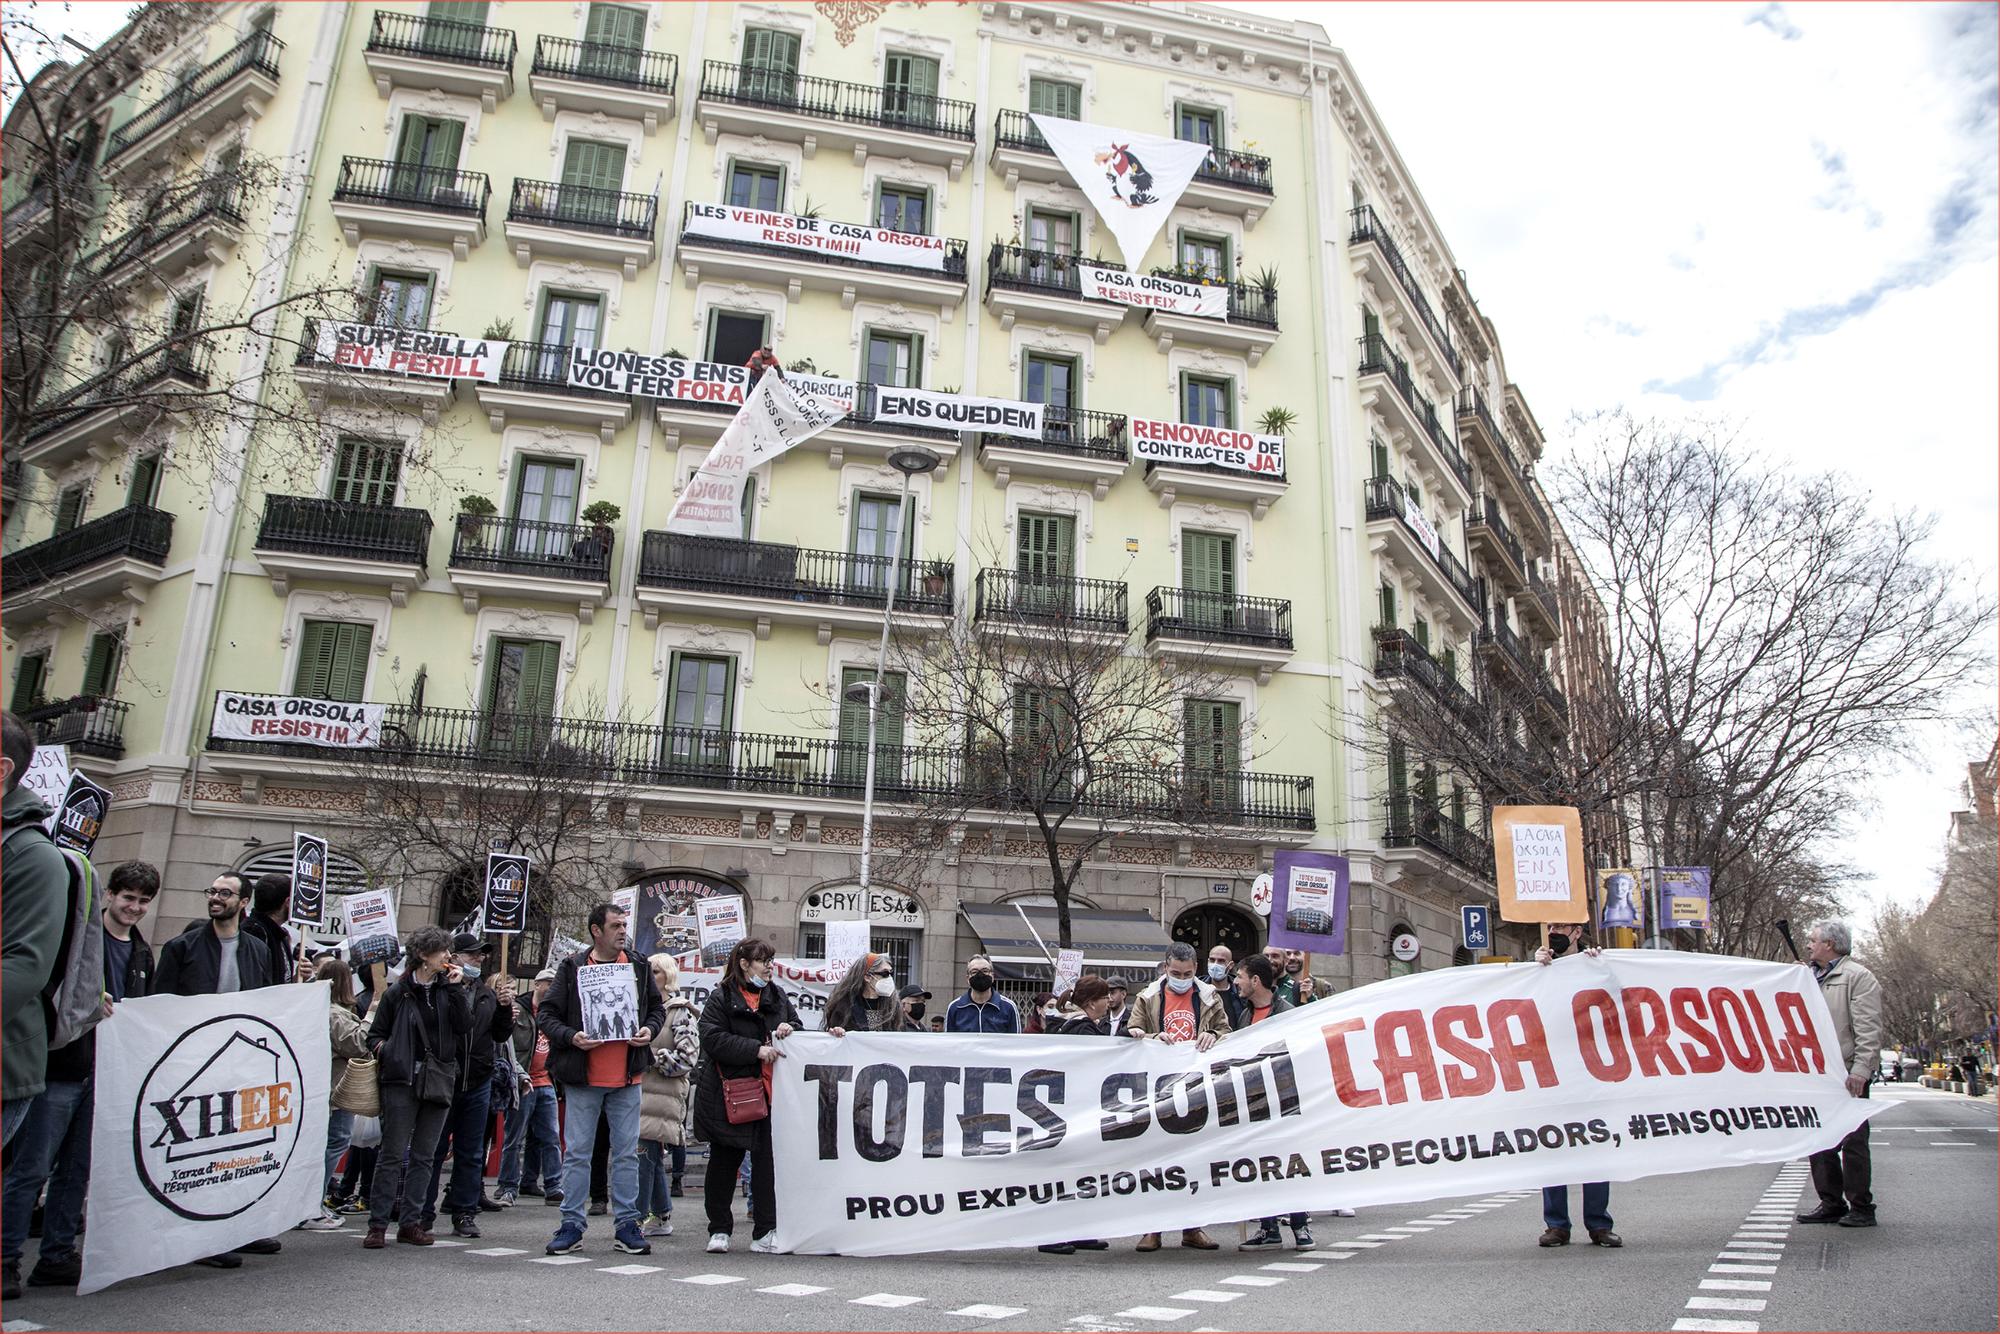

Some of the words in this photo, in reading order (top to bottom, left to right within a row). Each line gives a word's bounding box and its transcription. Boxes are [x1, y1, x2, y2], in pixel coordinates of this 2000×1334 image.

[695, 204, 726, 219] LES
[797, 219, 818, 232] DE
[829, 224, 872, 241] CASA
[877, 231, 943, 250] ORSOLA
[1095, 271, 1134, 288] CASA
[1141, 277, 1202, 299] ORSOLA
[1097, 286, 1177, 309] RESISTEIX
[340, 325, 488, 358] SUPERILLA
[335, 343, 374, 367] EN
[388, 351, 485, 378] PERILL
[574, 347, 685, 378] LIONESS
[694, 363, 745, 384] ENS
[573, 365, 618, 390] VOL
[625, 373, 674, 398] FER
[677, 379, 744, 404] FORA
[881, 396, 932, 417] ENS
[935, 402, 1035, 430] QUEDEM
[1138, 441, 1245, 465] CONTRACTES
[1258, 441, 1280, 455] DE
[224, 697, 277, 716] CASA
[284, 700, 365, 724] ORSOLA
[251, 719, 349, 744] RESISTIM
[25, 773, 66, 789] SOLA
[1515, 828, 1534, 841] LA
[1536, 829, 1562, 842] CASA
[1517, 860, 1556, 875] ENS
[1518, 880, 1568, 895] QUEDEM
[806, 910, 820, 918] 137
[822, 892, 906, 913] CRYESA
[903, 915, 918, 923] 137
[1470, 912, 1480, 928] P
[580, 965, 630, 976] BLACKSTONE
[1322, 998, 1559, 1108] CASA
[1571, 986, 1825, 1083] ORSOLA
[149, 1081, 293, 1148] XHEE
[804, 1063, 1066, 1161] TOTES
[171, 1167, 205, 1181] Xarxa
[263, 1150, 274, 1162] de
[846, 1192, 945, 1221] PROU
[957, 1165, 1200, 1212] EXPULSIONS,
[1211, 1153, 1312, 1190] FORA
[1321, 1118, 1621, 1175] ESPECULADORS,
[1629, 1105, 1821, 1141] #ENSQUEDEM!
[163, 1175, 219, 1194] l'Esquerra
[220, 1170, 233, 1183] de
